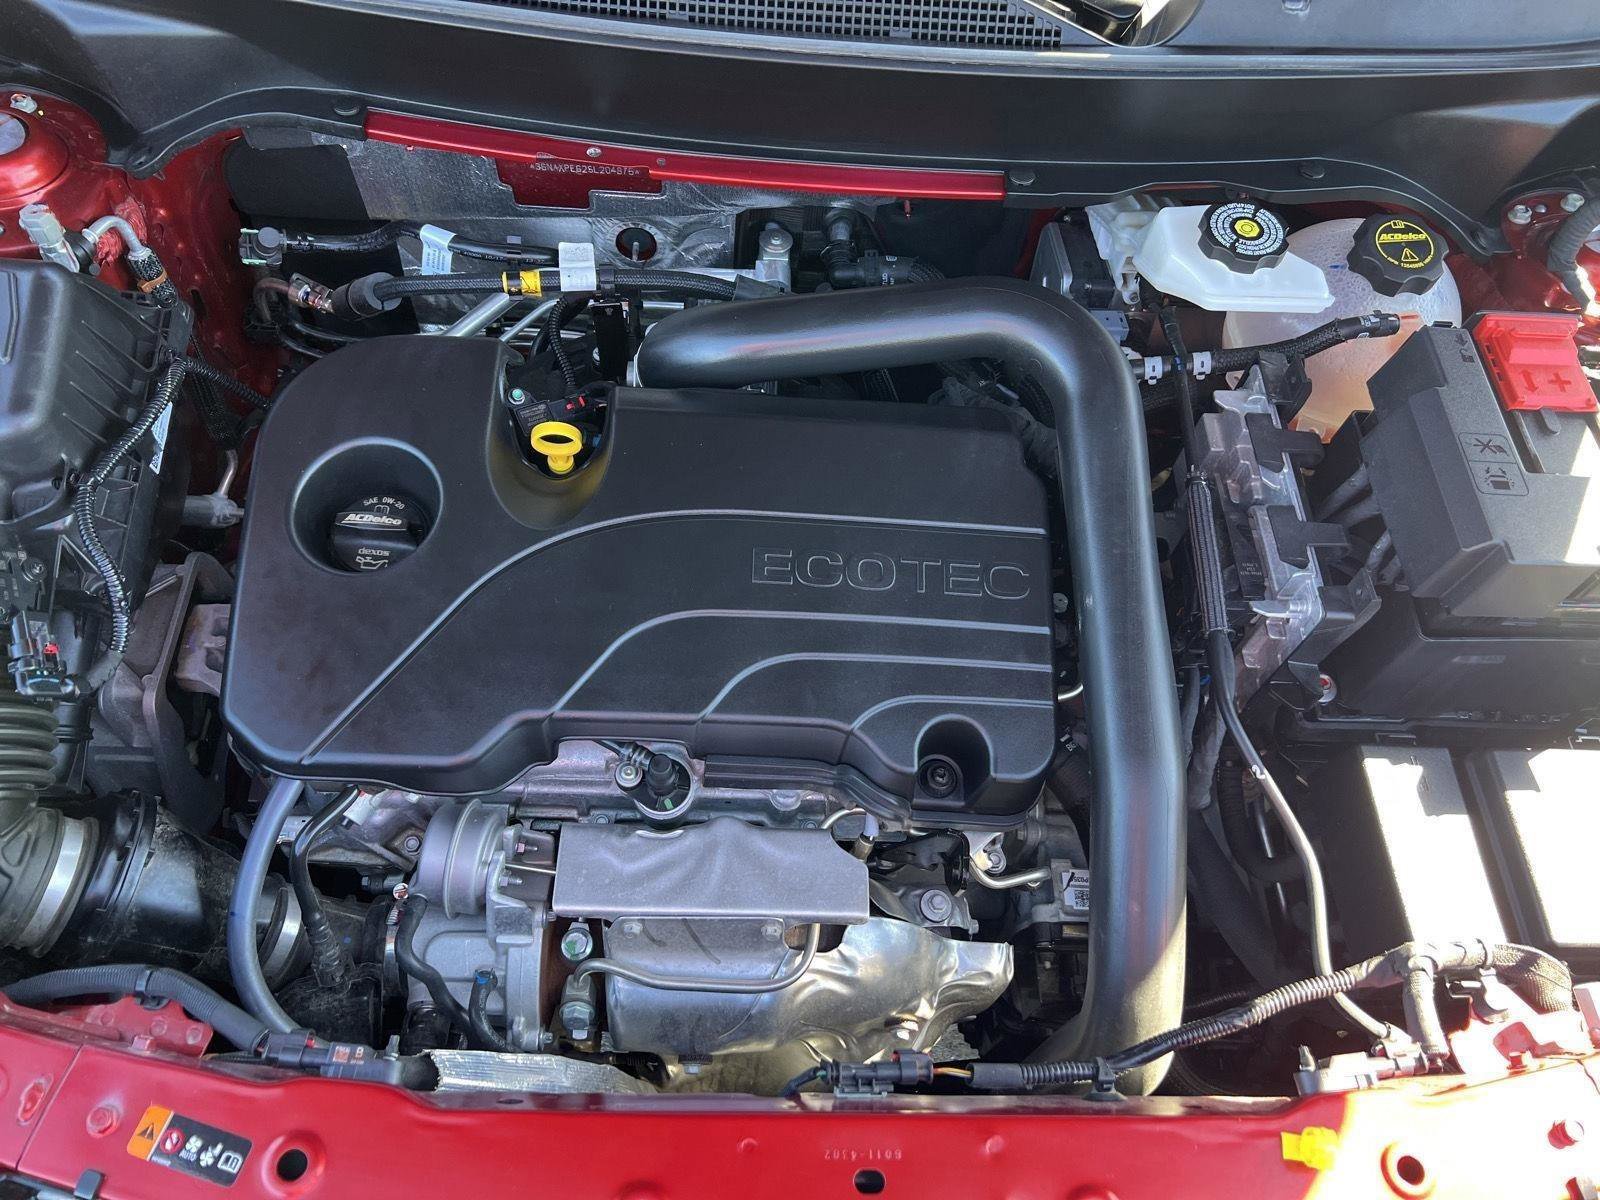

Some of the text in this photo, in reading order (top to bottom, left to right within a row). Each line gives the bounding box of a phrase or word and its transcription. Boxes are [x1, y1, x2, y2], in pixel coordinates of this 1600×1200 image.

[1379, 232, 1426, 241] ACDelco
[364, 496, 405, 509] SAE 0W-20
[344, 513, 402, 525] ACDelco
[358, 547, 391, 557] dexos
[752, 547, 1030, 600] ECOTEC
